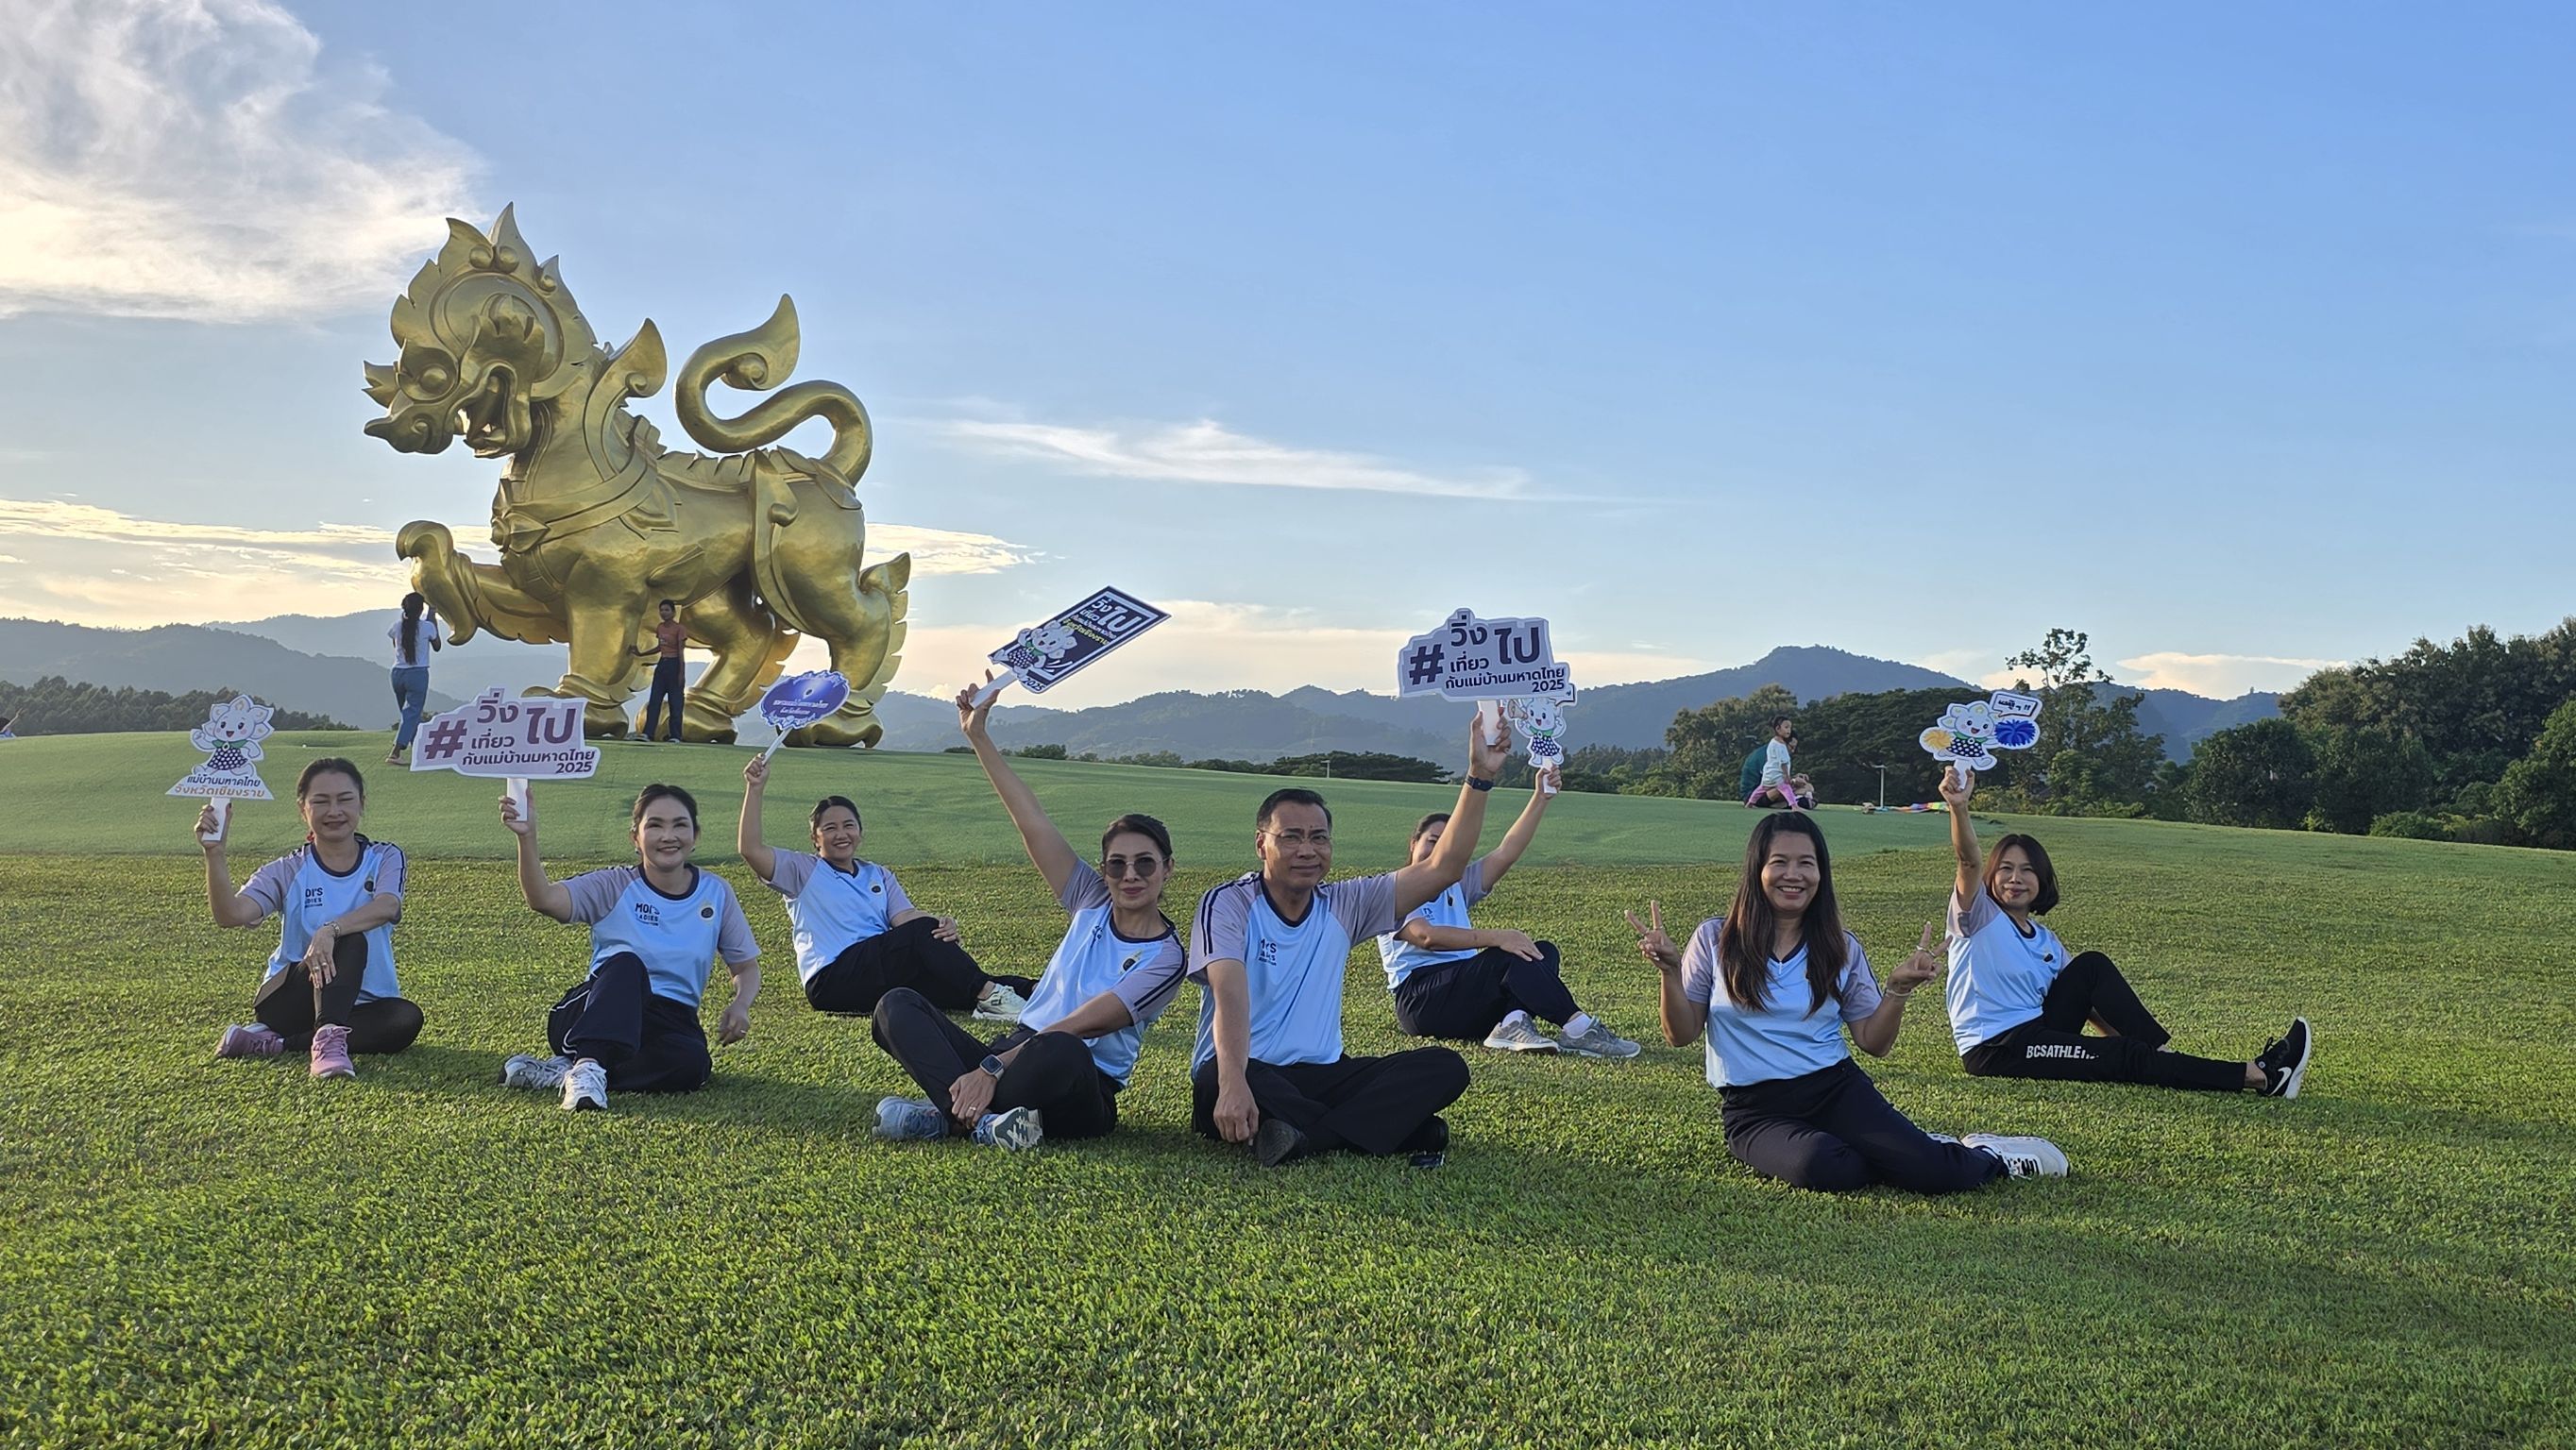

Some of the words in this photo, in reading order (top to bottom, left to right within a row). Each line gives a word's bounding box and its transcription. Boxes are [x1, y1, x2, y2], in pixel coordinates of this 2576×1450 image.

[1097, 606, 1143, 632] ไป
[1450, 615, 1488, 647] วิ่ง
[1494, 627, 1540, 665] ไป
[1450, 651, 1489, 673] เที่ยว
[1445, 666, 1565, 689] กับแม่บ้านมหาดไทย
[1532, 678, 1565, 693] 2025
[477, 692, 518, 723] วิ่ง
[527, 707, 576, 744] ไป
[471, 729, 515, 750] เที่ยว
[463, 749, 596, 766] กับแม่บ้านมหาดไทย
[555, 761, 592, 774] 2025
